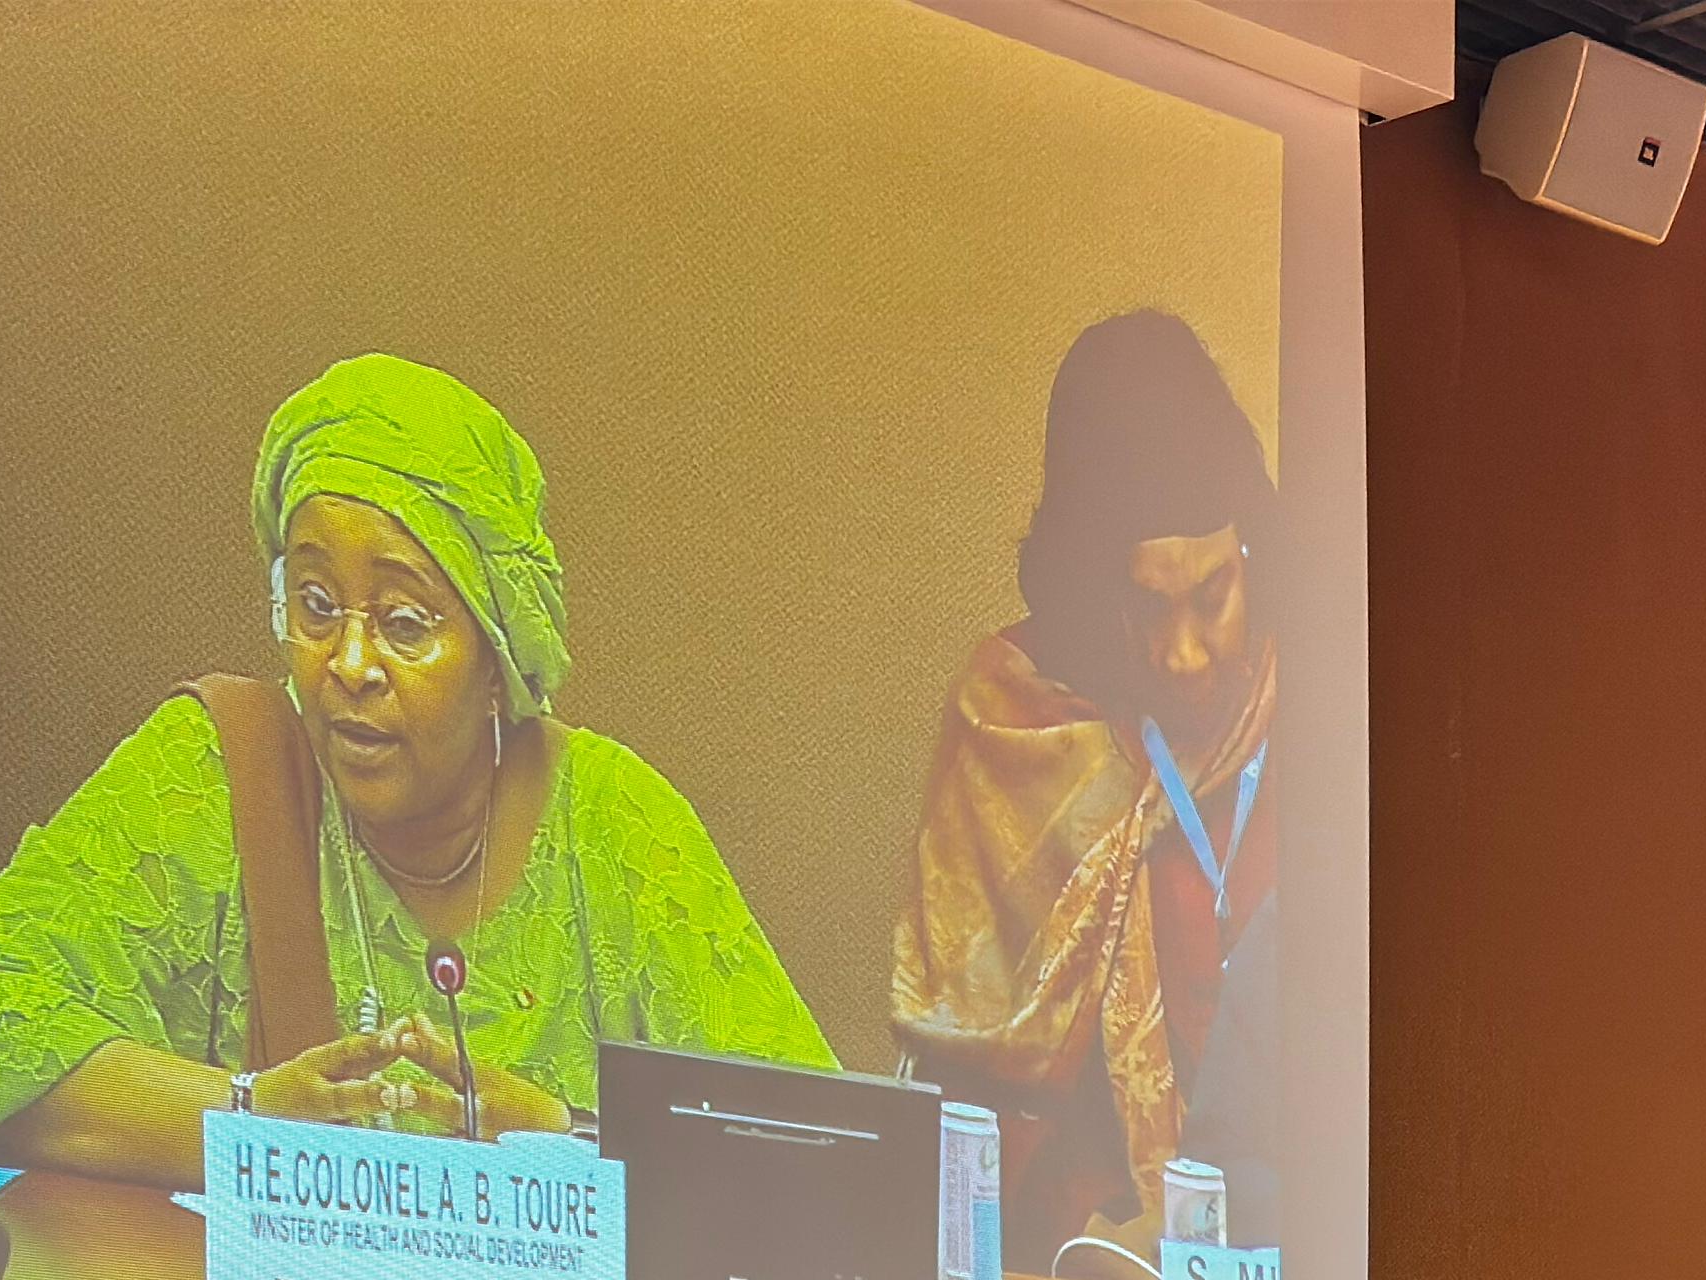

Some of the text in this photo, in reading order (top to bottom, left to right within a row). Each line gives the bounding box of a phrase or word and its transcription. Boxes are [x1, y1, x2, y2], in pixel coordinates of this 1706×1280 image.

[438, 1167, 463, 1222] A.
[475, 1170, 500, 1226] B.
[250, 1212, 584, 1272] MINISTER OF HEALTH AND SOCIAL DEVELOPMENT
